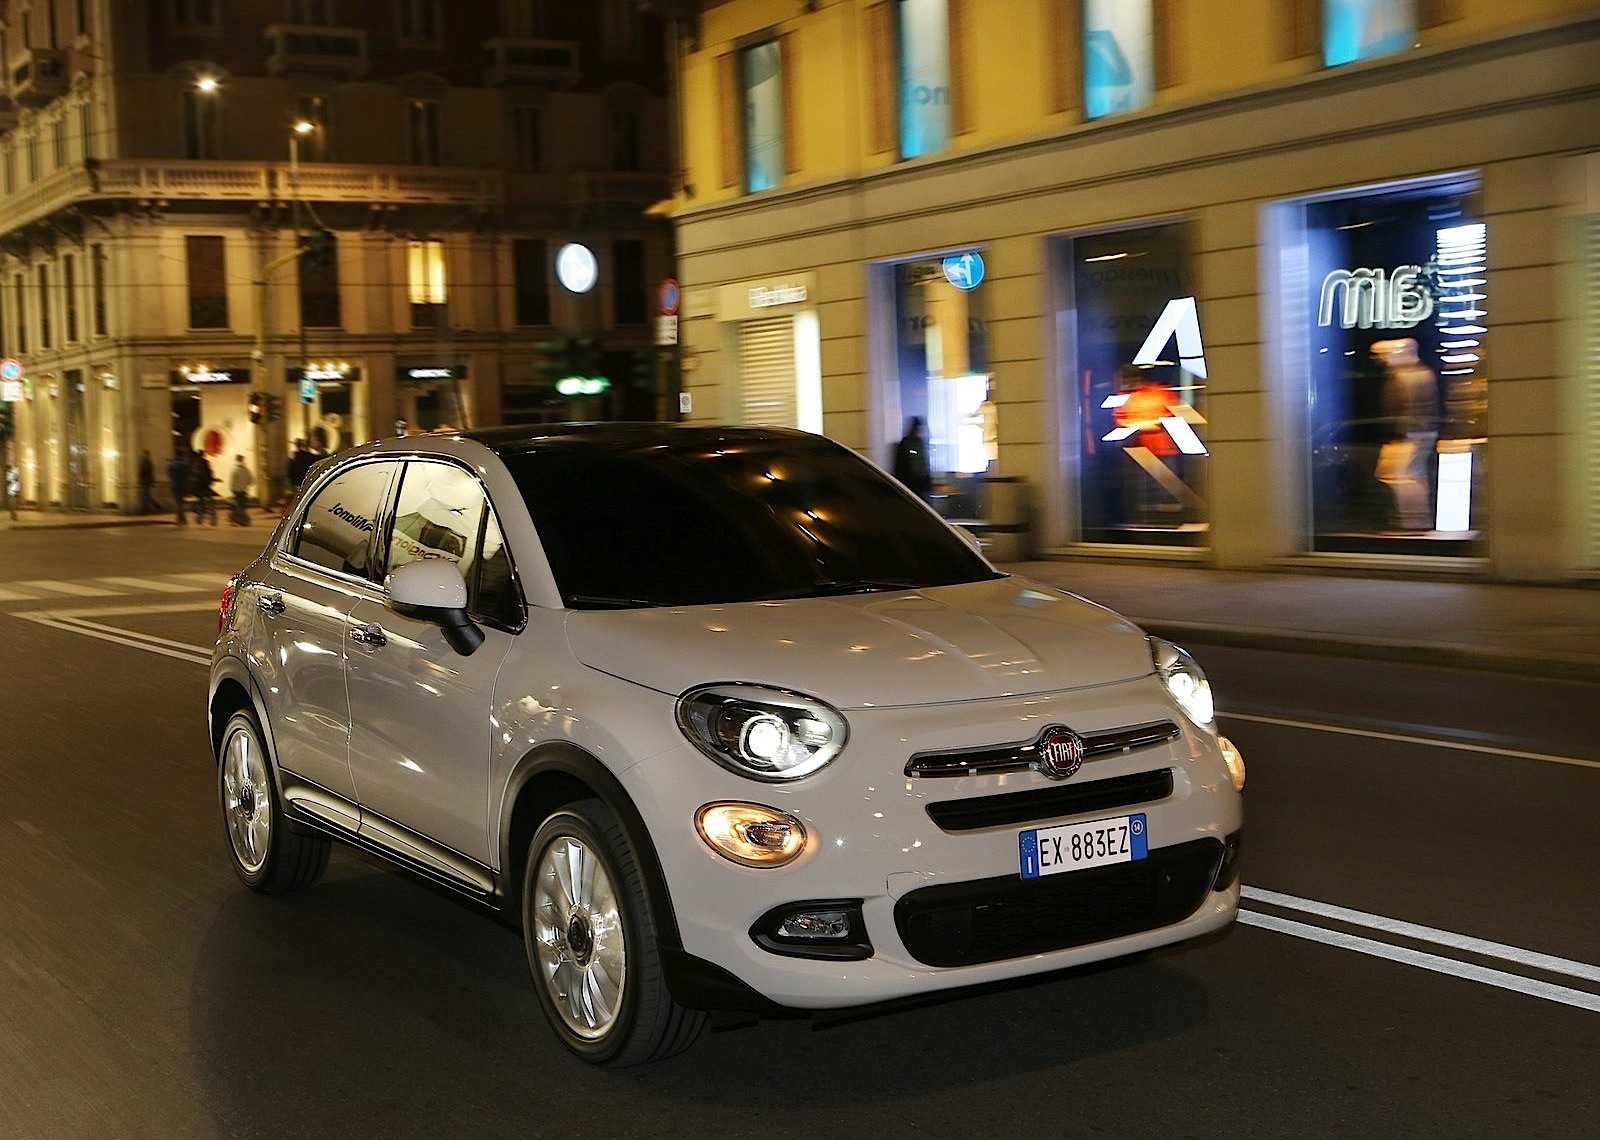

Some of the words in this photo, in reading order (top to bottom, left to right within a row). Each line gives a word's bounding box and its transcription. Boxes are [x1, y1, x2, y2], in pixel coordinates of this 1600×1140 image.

[1050, 742, 1075, 763] FIAT
[1039, 836, 1063, 867] EX
[1071, 826, 1129, 862] 883EZ
